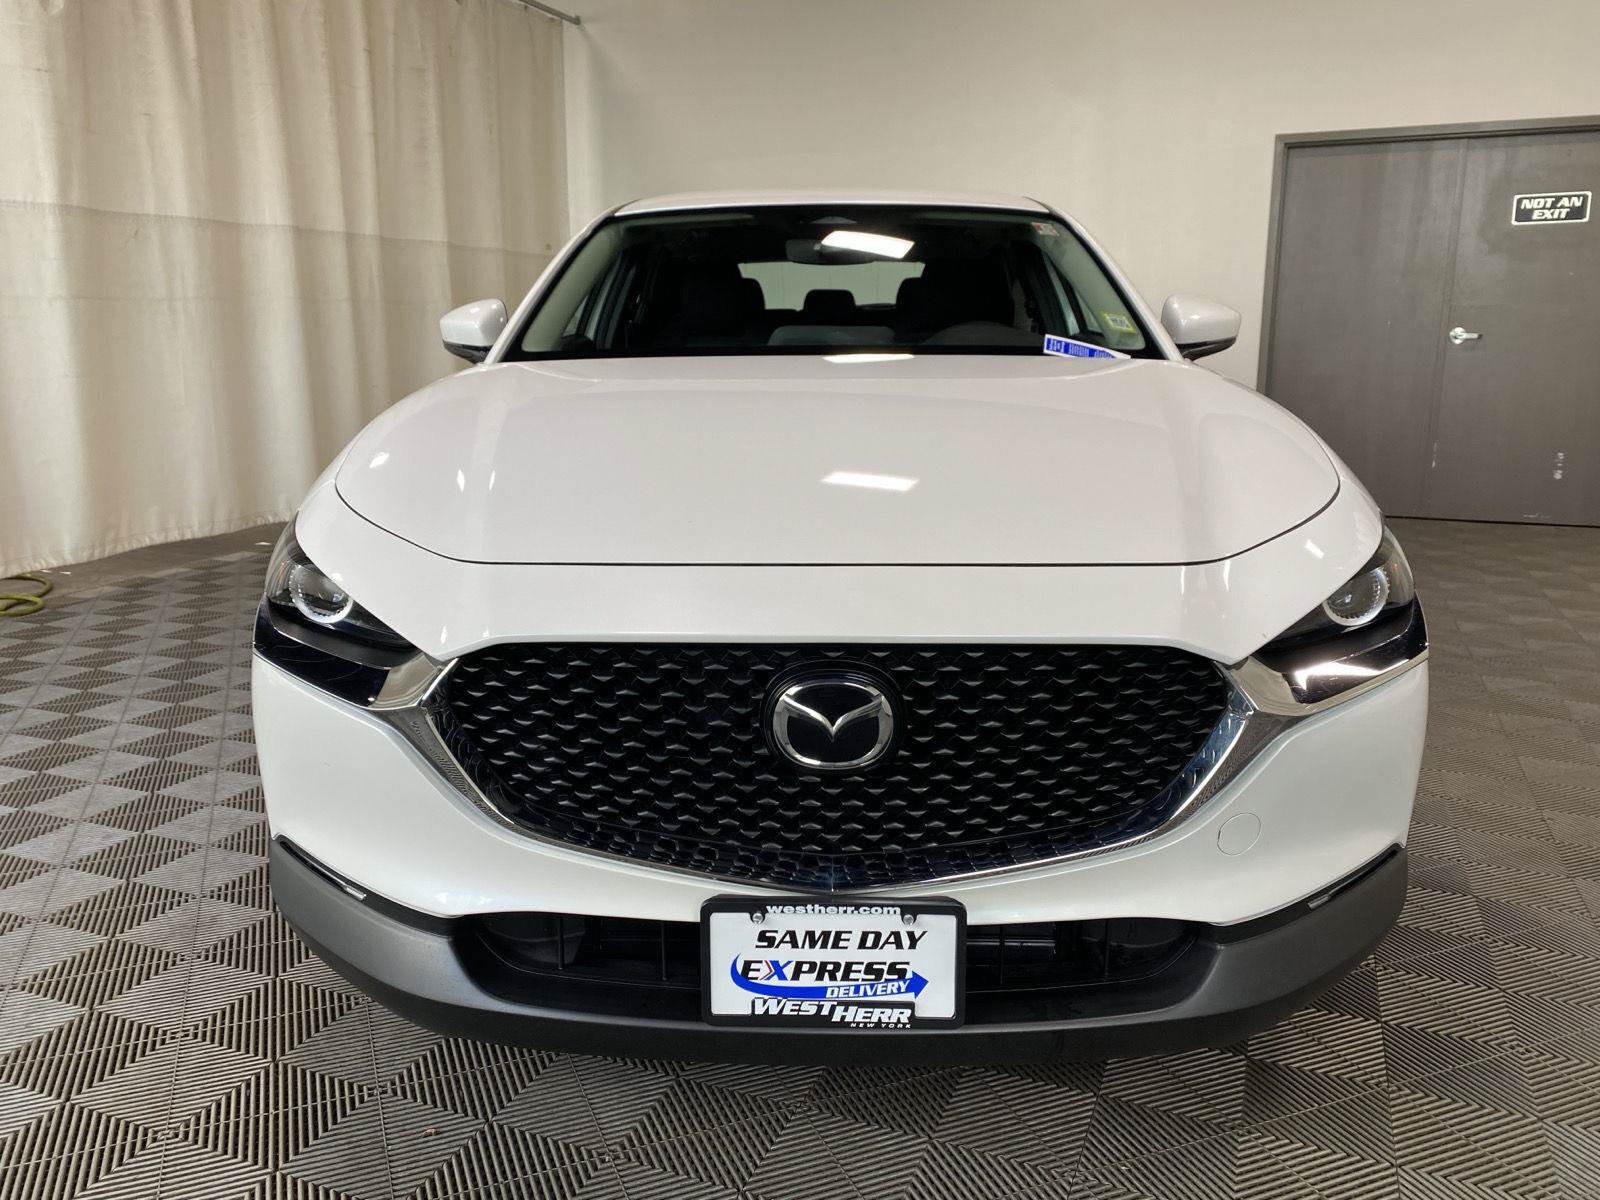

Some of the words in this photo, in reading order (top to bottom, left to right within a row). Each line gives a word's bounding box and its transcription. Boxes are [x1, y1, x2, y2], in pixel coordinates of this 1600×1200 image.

[1520, 197, 1555, 209] NOT
[1557, 196, 1583, 208] AN
[1532, 208, 1570, 220] EXIT
[766, 904, 900, 915] westherr.com
[755, 930, 852, 950] SAME
[857, 930, 928, 950] DAY
[741, 959, 910, 982] EXPRESS
[826, 979, 911, 999] DELIVERY
